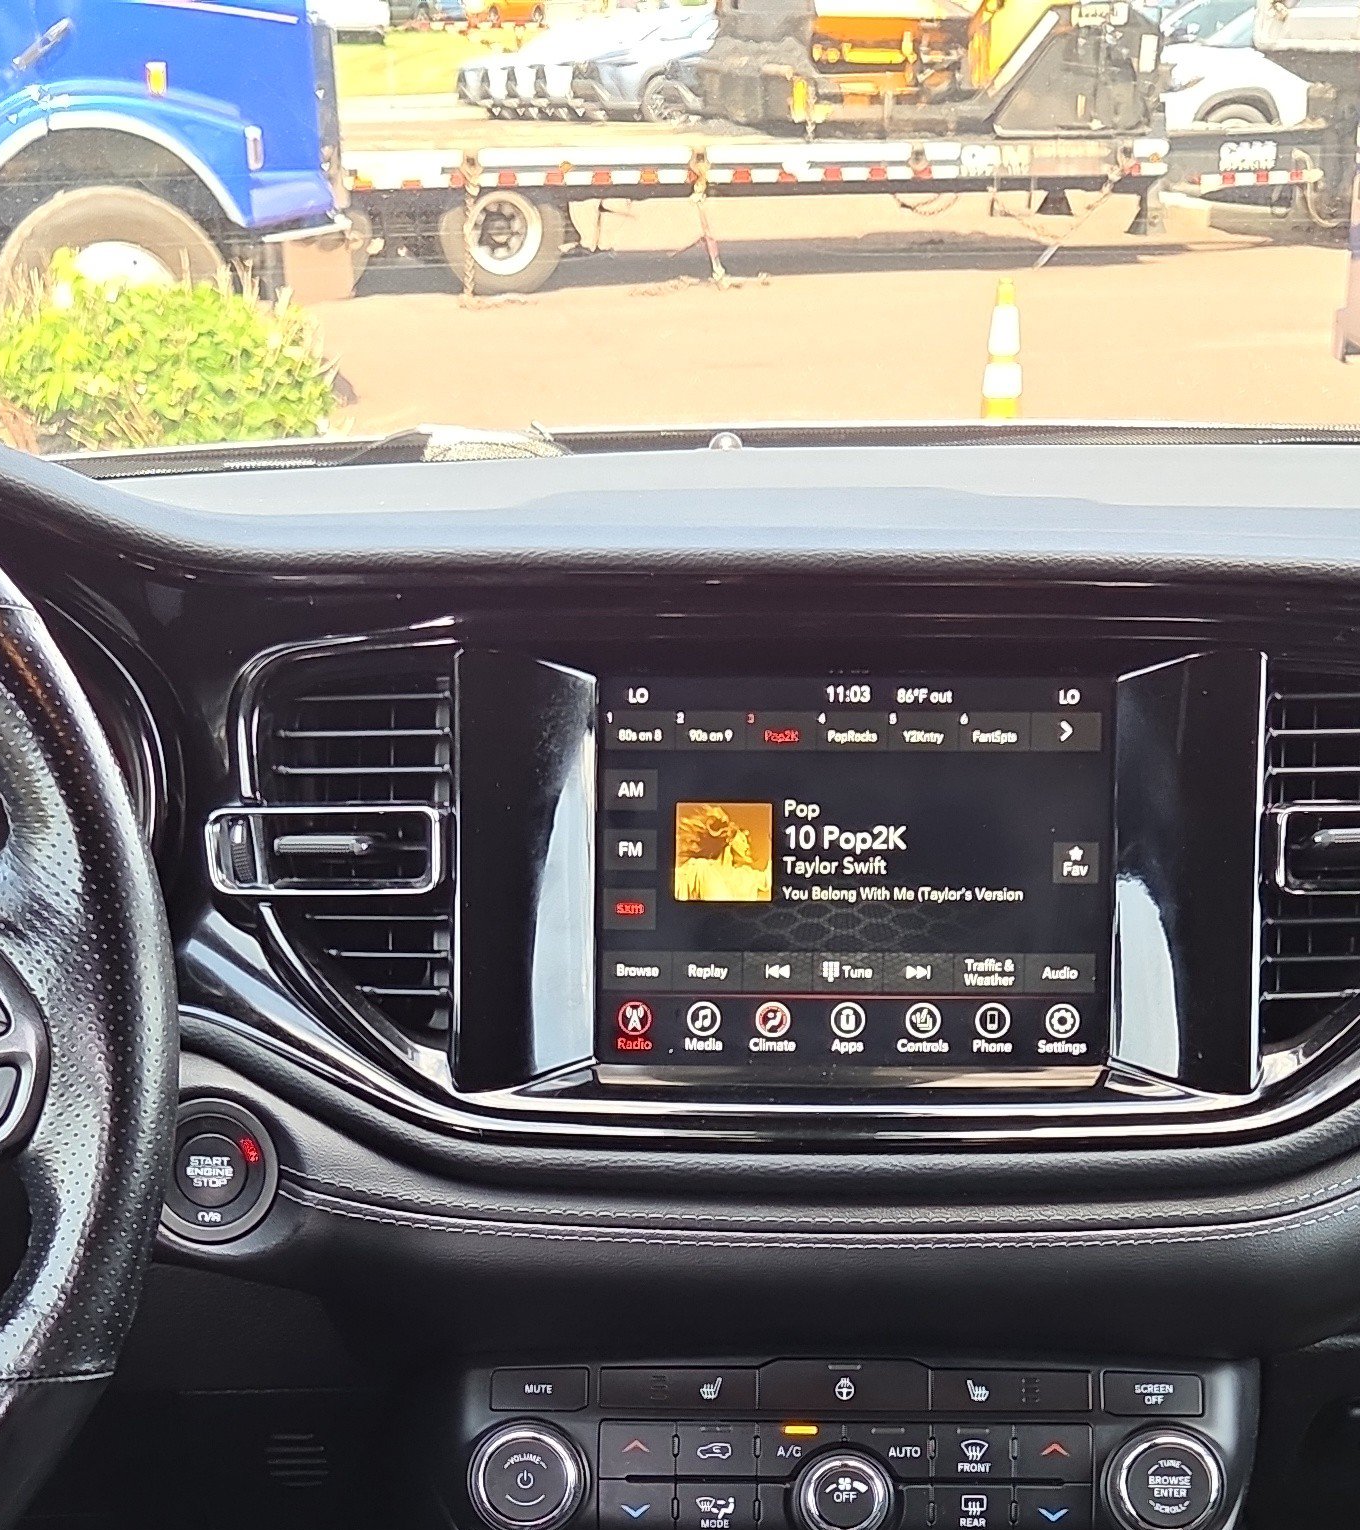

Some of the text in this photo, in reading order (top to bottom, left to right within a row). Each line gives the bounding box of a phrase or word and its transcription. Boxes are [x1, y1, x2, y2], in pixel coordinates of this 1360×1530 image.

[628, 687, 649, 703] LO
[826, 685, 871, 703] 11:03
[930, 690, 953, 704] out
[1059, 689, 1080, 705] LO
[607, 711, 613, 724] 1
[676, 711, 685, 725] 2
[817, 712, 826, 725] 4
[725, 728, 734, 742] 9
[764, 729, 799, 744] Pop2K
[827, 729, 878, 745] PopRocks
[618, 781, 644, 798] AM
[784, 799, 820, 821] Pop
[785, 825, 907, 854] 10 Pop2K
[618, 841, 643, 857] FM
[783, 855, 887, 878] Taylor Swift
[1062, 861, 1089, 877] Fav
[782, 886, 1023, 903] You Belong With Me (Taylor's Version
[616, 964, 659, 978] Browse
[688, 964, 728, 980] Replay
[964, 959, 1015, 972] Traffic &
[842, 966, 873, 979] Tune
[1042, 966, 1078, 980] Audio
[964, 973, 1015, 987] Weather
[617, 1038, 652, 1050] Radio
[685, 1038, 723, 1051] Media
[749, 1038, 796, 1052] Climate
[831, 1039, 864, 1054] Apps
[897, 1039, 949, 1053] Controls
[973, 1040, 1013, 1053] Phone
[1038, 1040, 1087, 1055] Settings
[189, 1155, 231, 1167] START
[186, 1166, 234, 1177] ENGINE
[193, 1177, 228, 1188] STOP
[525, 1384, 552, 1394] MUTE
[1134, 1384, 1174, 1394] SCREEN
[1144, 1395, 1165, 1405] OFF
[777, 1446, 802, 1458] A/C
[889, 1447, 921, 1458] AUTO
[508, 1453, 542, 1465] VOLUME
[1158, 1459, 1182, 1469] TUNE
[957, 1462, 991, 1473] FRONT
[1148, 1475, 1191, 1486] BROWSE
[833, 1491, 857, 1504] OFF
[1154, 1488, 1187, 1498] ENTER
[1153, 1503, 1187, 1514] SCROLL
[700, 1518, 730, 1529] MODE
[959, 1517, 986, 1528] REAR
